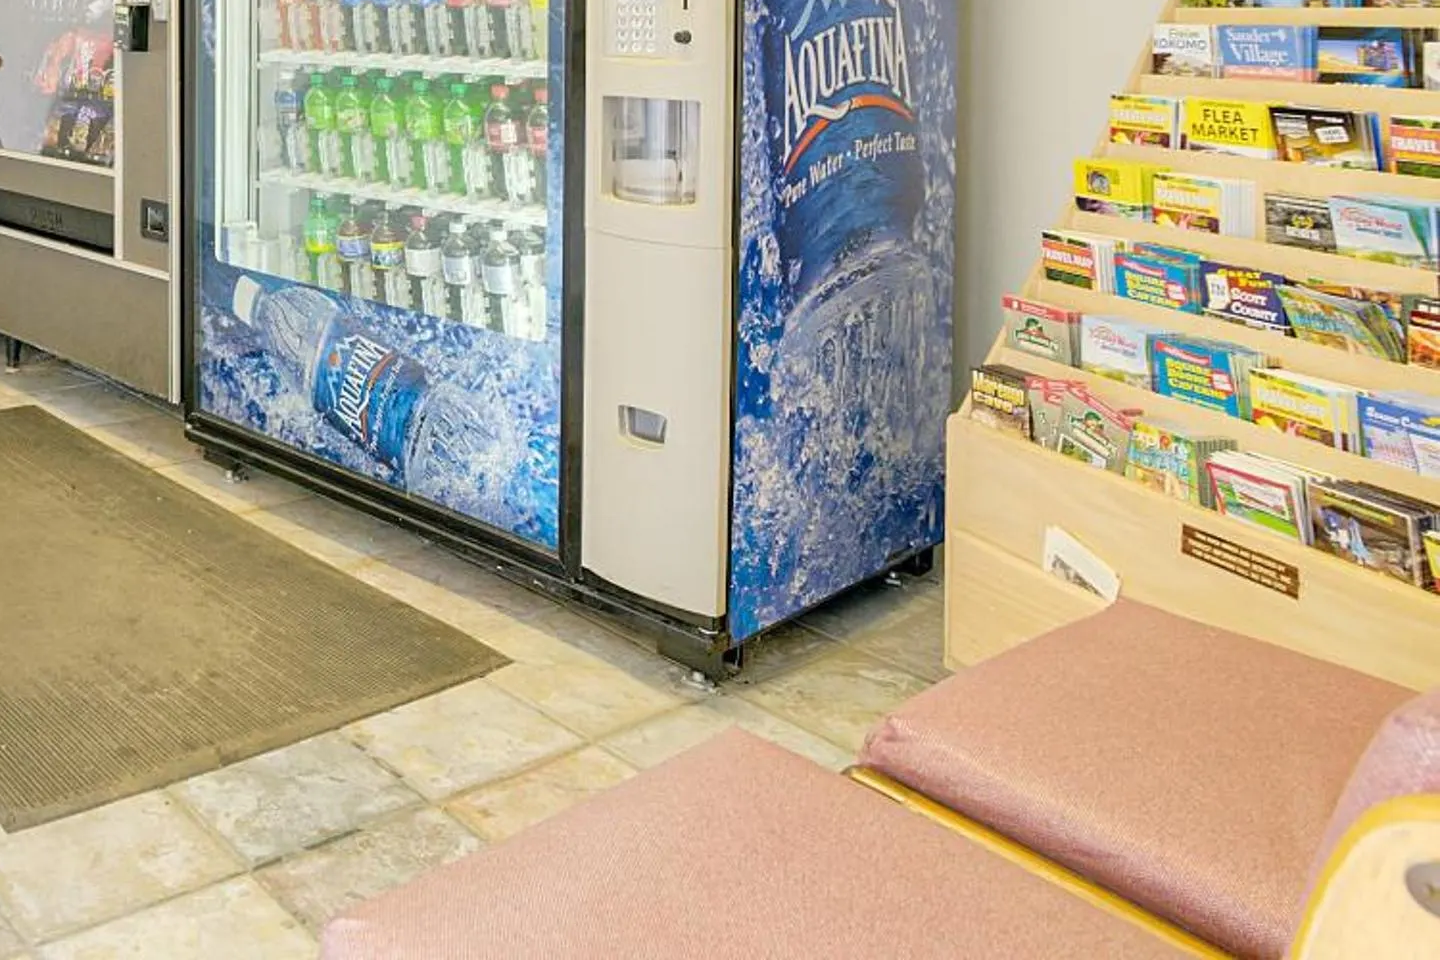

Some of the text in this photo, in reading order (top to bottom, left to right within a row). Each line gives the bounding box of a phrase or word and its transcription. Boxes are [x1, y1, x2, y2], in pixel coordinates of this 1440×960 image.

[1229, 43, 1289, 67] Village
[783, 0, 913, 163] AQUAFINA
[1191, 124, 1259, 142] MARKET
[1202, 108, 1244, 125] FLEA
[783, 130, 917, 209] Pure Water Perfect Taste
[334, 335, 392, 442] AQUAFINA
